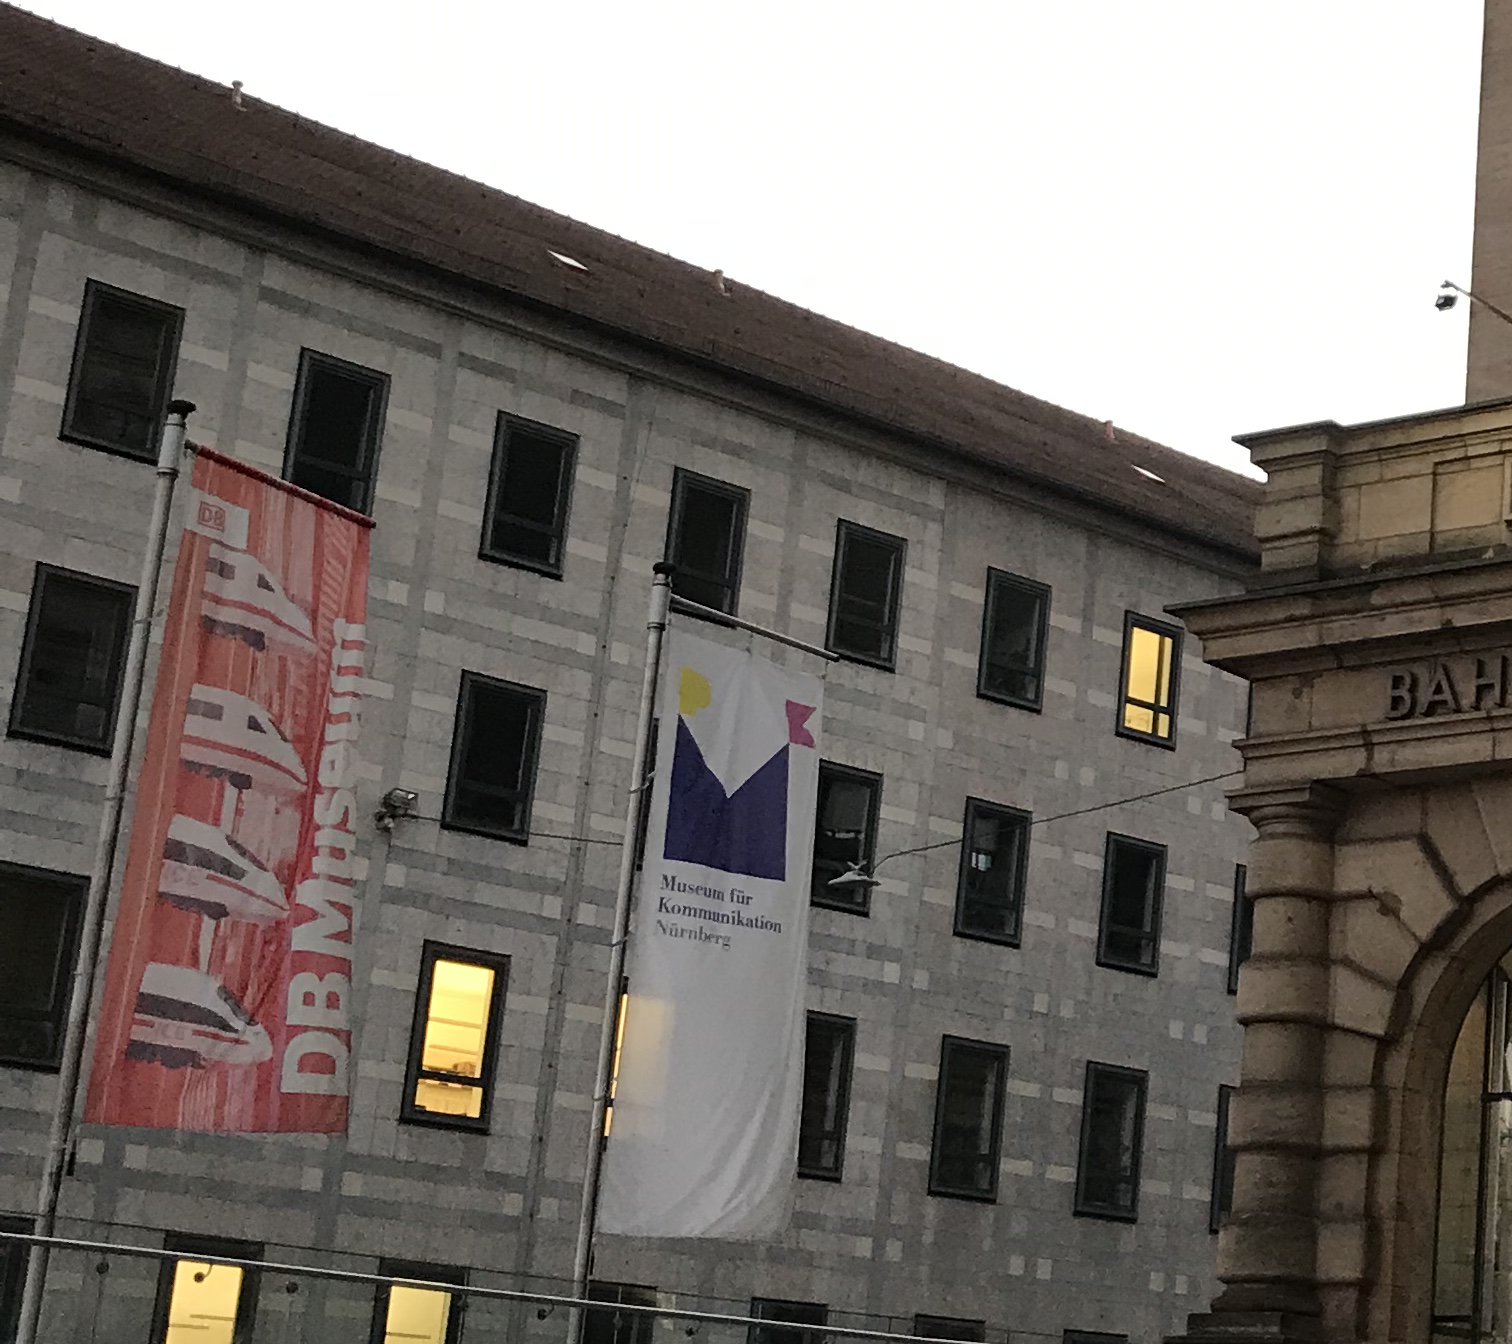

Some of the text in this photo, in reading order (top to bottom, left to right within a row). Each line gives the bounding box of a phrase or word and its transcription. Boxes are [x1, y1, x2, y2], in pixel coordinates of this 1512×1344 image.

[279, 617, 366, 1095] DB Museum
[660, 873, 754, 906] Museum für
[657, 895, 783, 934] Kommunikation
[655, 919, 733, 952] Nürnberg
